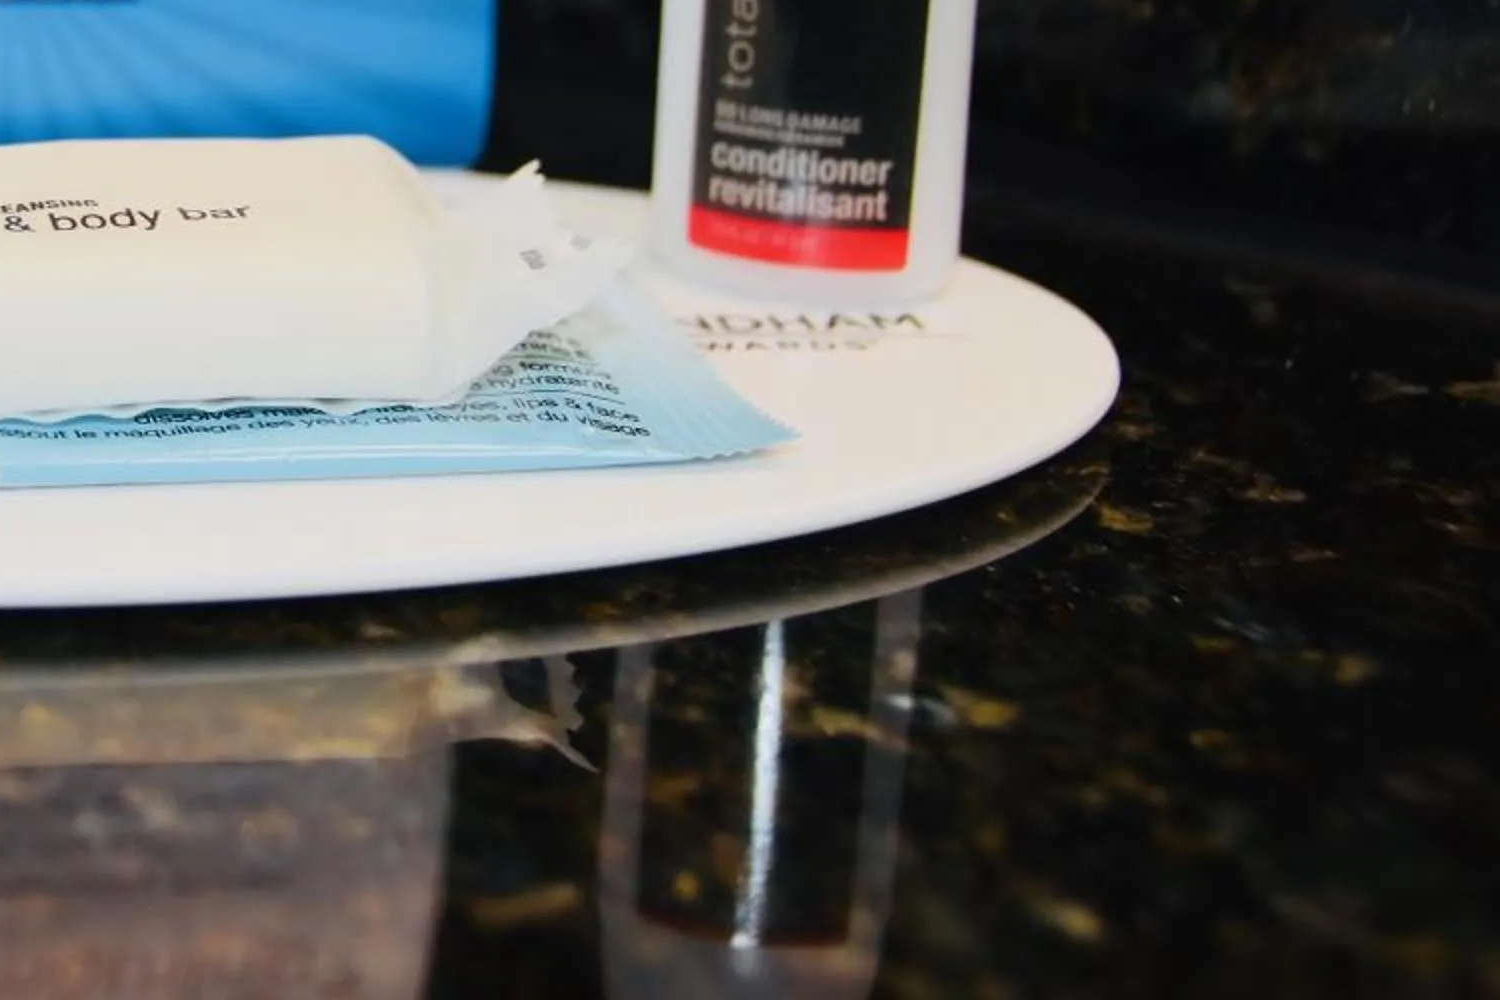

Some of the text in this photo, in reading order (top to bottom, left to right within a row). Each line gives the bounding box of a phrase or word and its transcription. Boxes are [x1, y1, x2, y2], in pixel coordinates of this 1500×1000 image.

[787, 110, 863, 135] DAMAGE
[710, 142, 895, 188] conditioner
[708, 175, 889, 223] revitalisant
[4, 214, 36, 234] &
[49, 205, 163, 233] body
[176, 203, 252, 223] bar
[75, 427, 98, 441] le
[105, 420, 242, 442] maquillage
